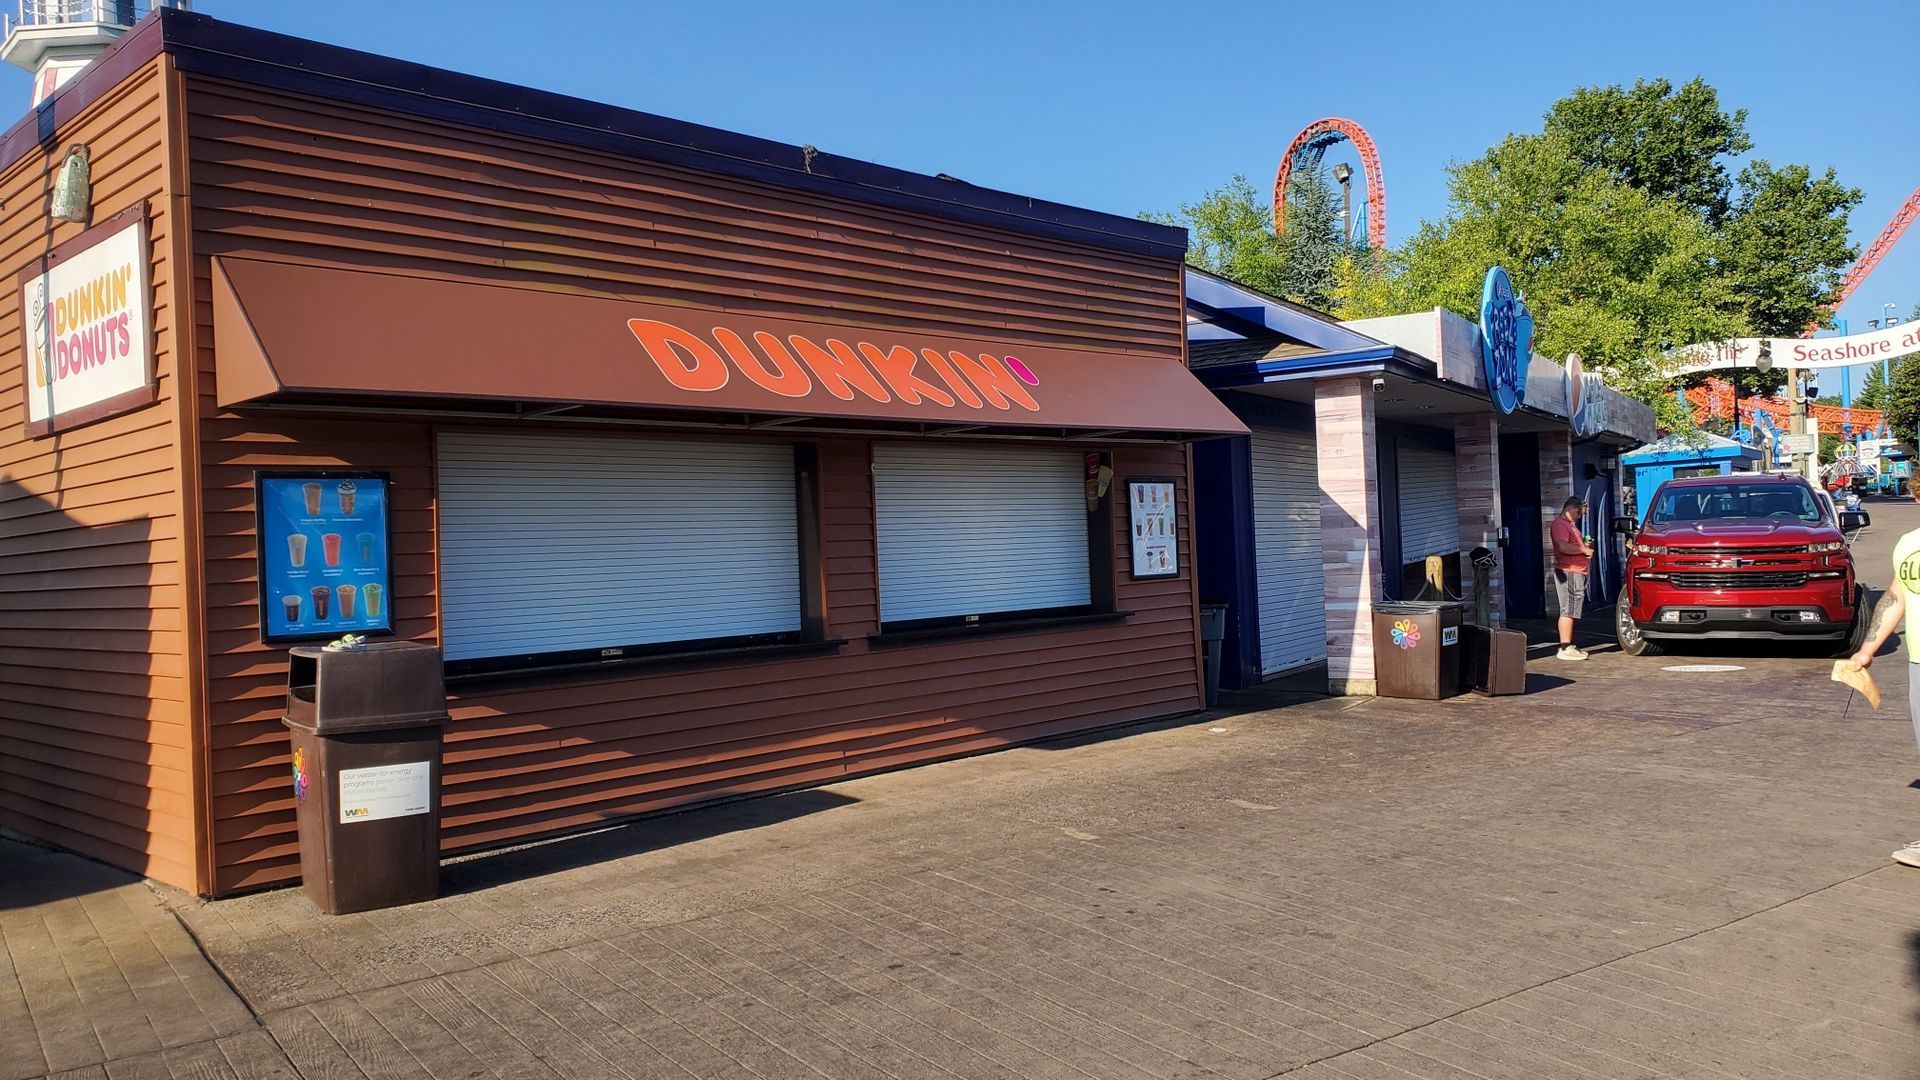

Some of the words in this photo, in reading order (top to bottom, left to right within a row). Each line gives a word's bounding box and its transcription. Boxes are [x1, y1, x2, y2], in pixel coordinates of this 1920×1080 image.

[55, 262, 132, 337] DUNKIN'
[57, 311, 130, 380] DONUTS
[627, 318, 1040, 412] DUNKIN'
[1793, 340, 1892, 362] Seashore
[1899, 561, 1920, 581] GL
[344, 780, 374, 789] programs
